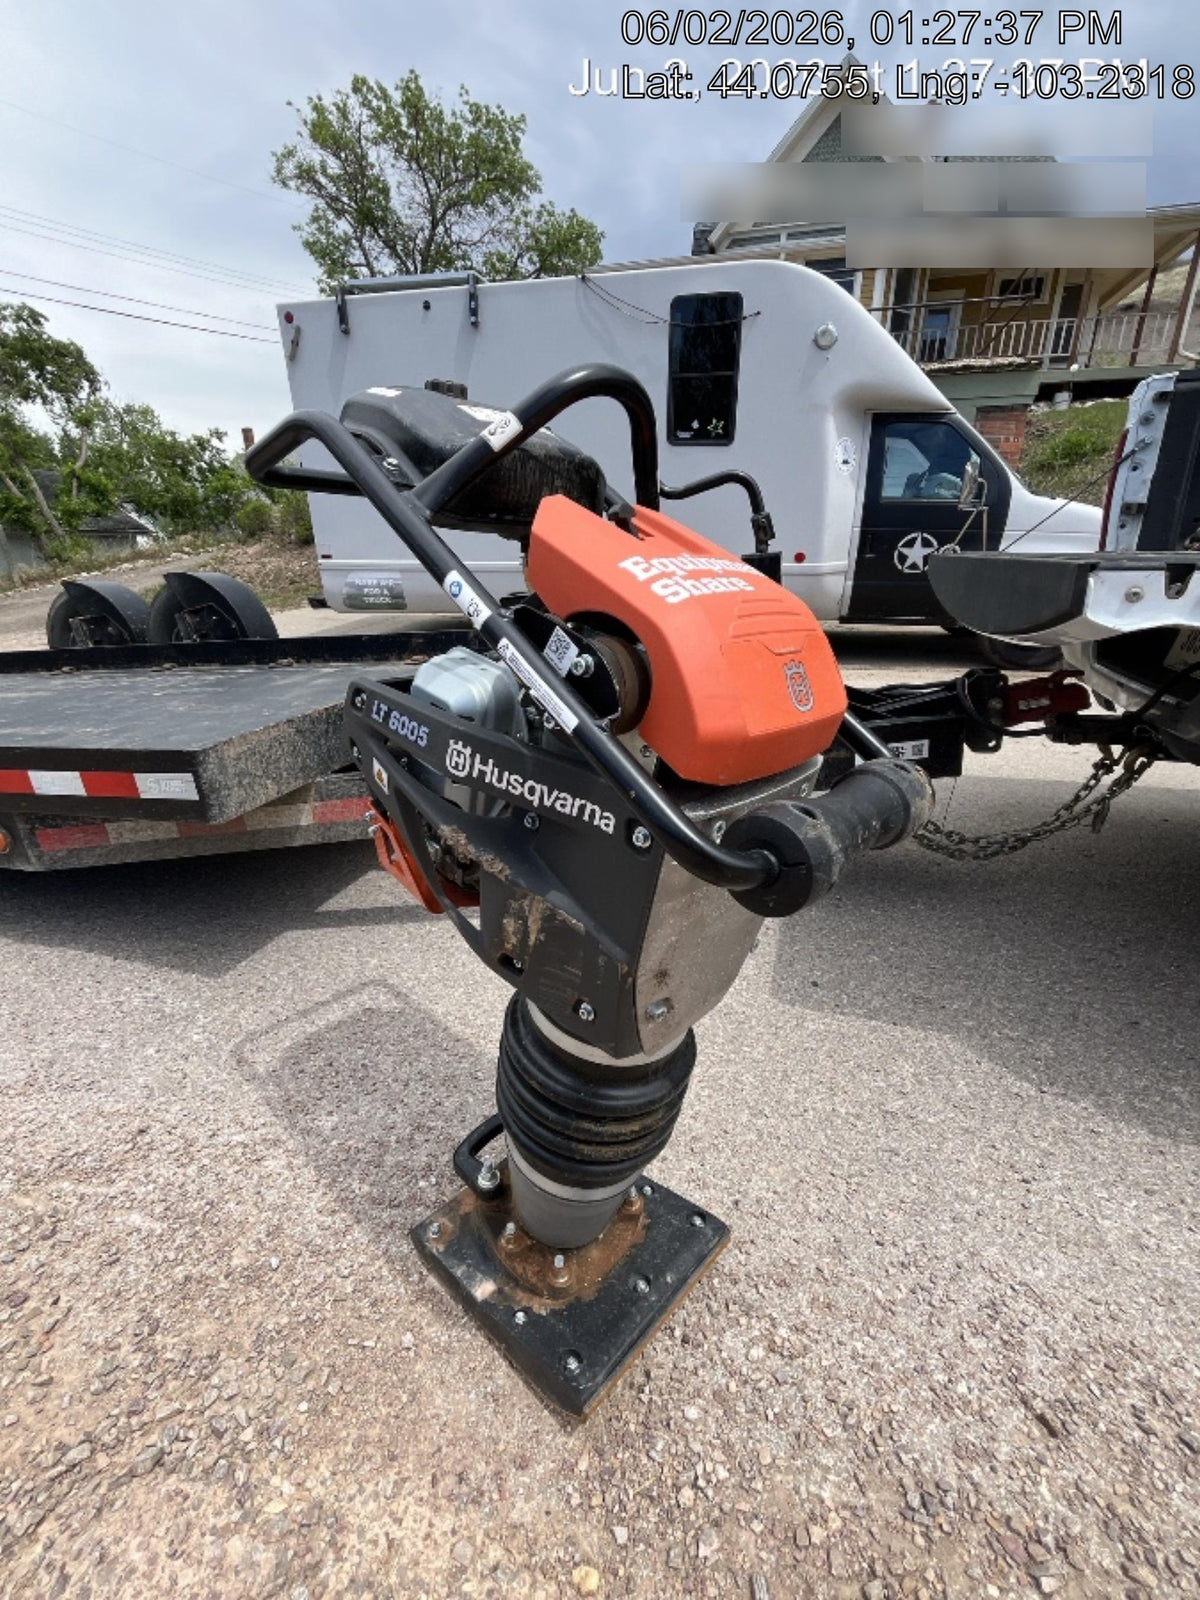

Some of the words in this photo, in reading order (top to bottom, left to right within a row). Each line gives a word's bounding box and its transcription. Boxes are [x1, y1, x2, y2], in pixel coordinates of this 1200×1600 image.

[617, 552, 766, 582] Equipm
[650, 575, 755, 604] Share
[370, 699, 388, 723] LT
[388, 710, 430, 747] 6005
[472, 752, 617, 835] Husqvarna
